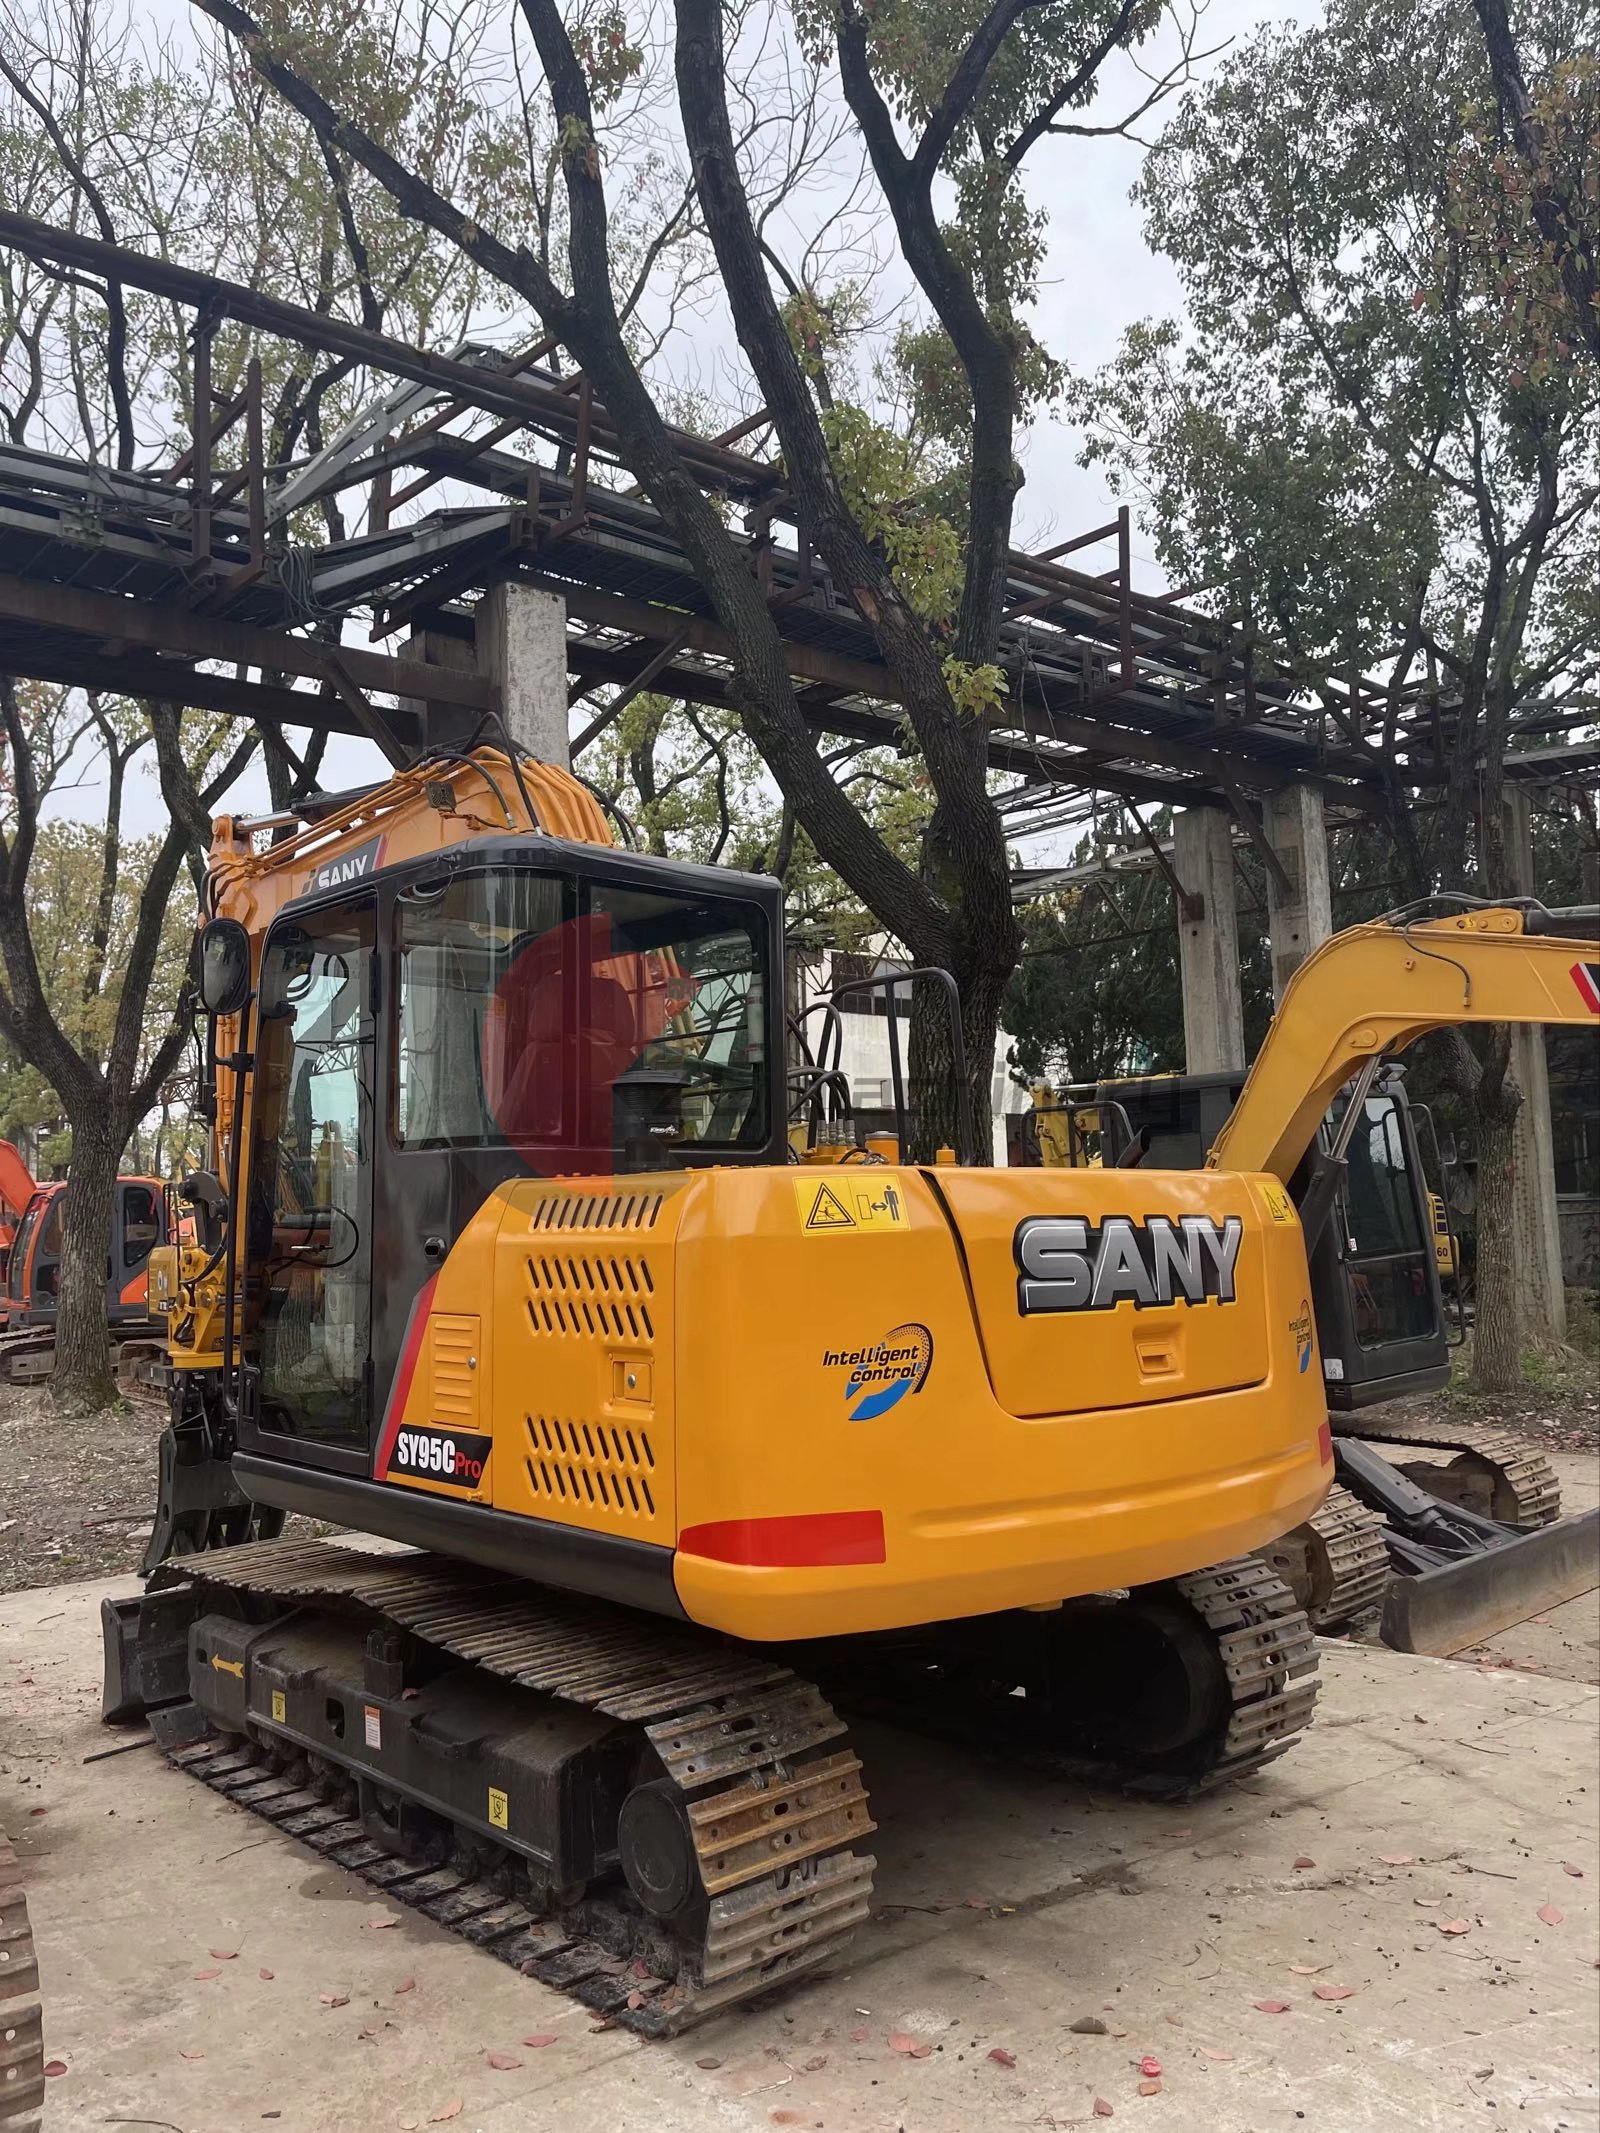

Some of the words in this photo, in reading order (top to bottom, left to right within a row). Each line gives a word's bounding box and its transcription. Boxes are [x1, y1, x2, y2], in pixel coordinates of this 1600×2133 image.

[317, 854, 368, 891] SANY
[1015, 1215, 1242, 1315] SANY
[822, 1345, 921, 1367] Intelligent
[849, 1362, 918, 1383] control
